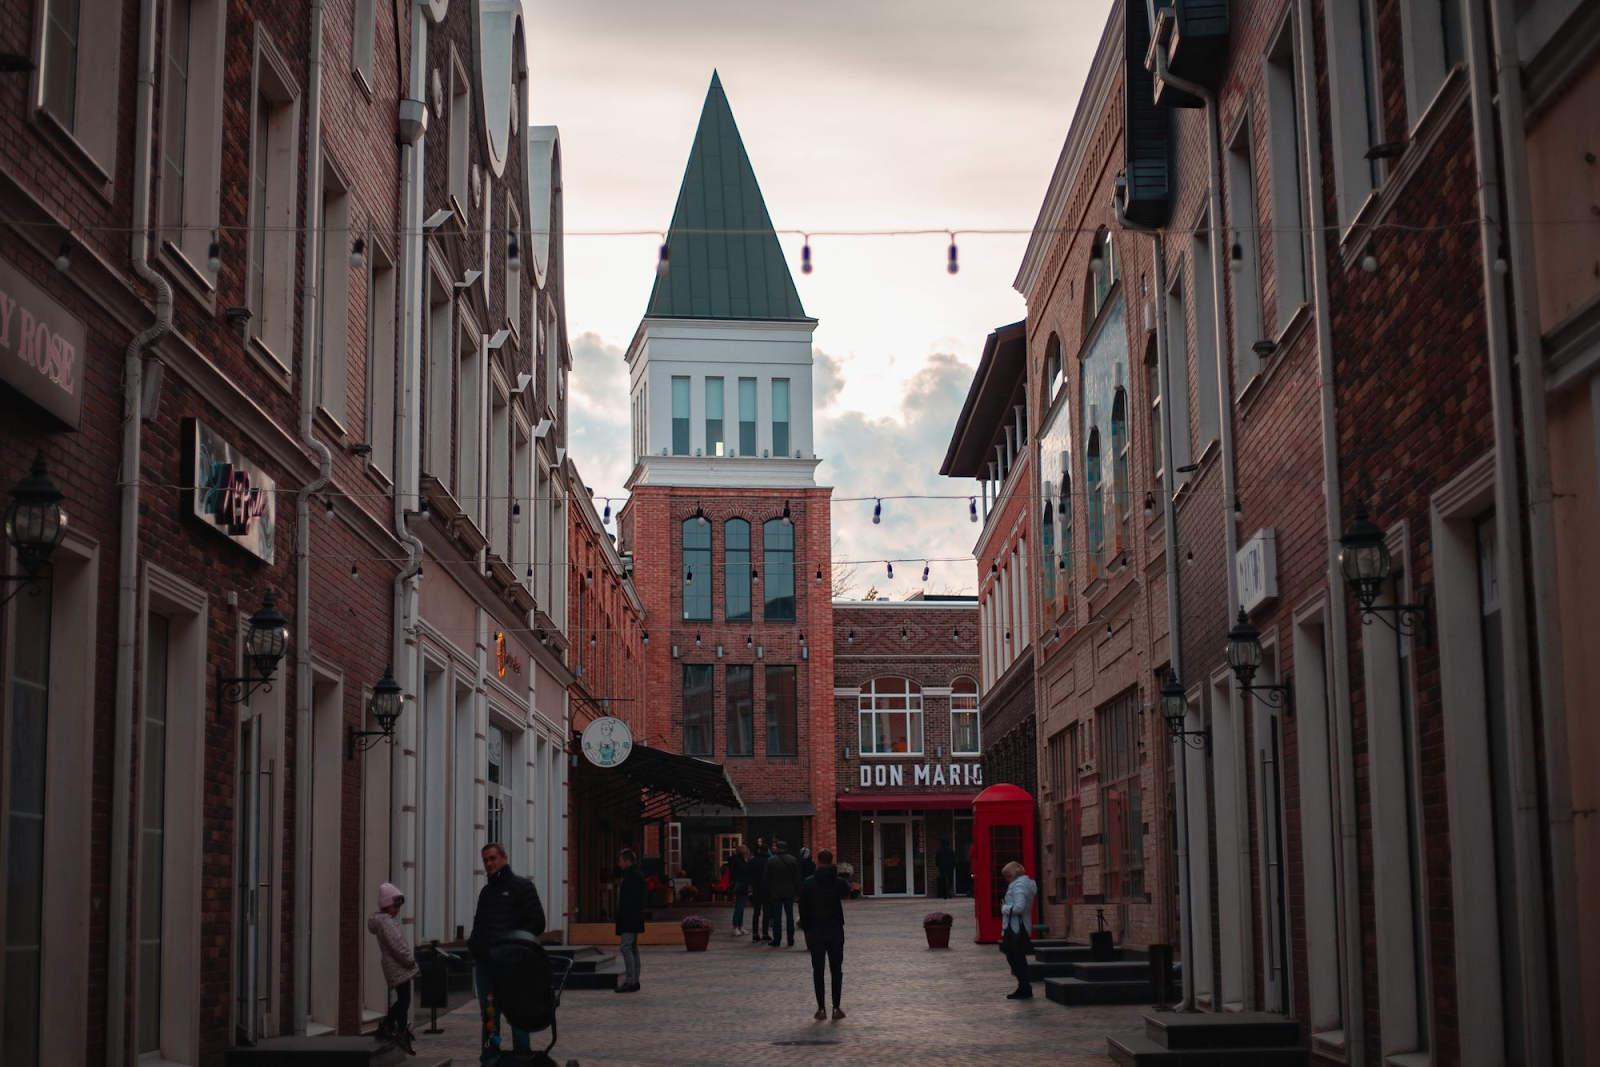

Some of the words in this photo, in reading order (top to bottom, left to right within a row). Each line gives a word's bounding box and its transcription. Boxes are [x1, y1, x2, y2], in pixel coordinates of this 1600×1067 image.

[18, 305, 75, 395] ROSE
[860, 764, 903, 786] DON
[914, 763, 983, 786] MARIO
